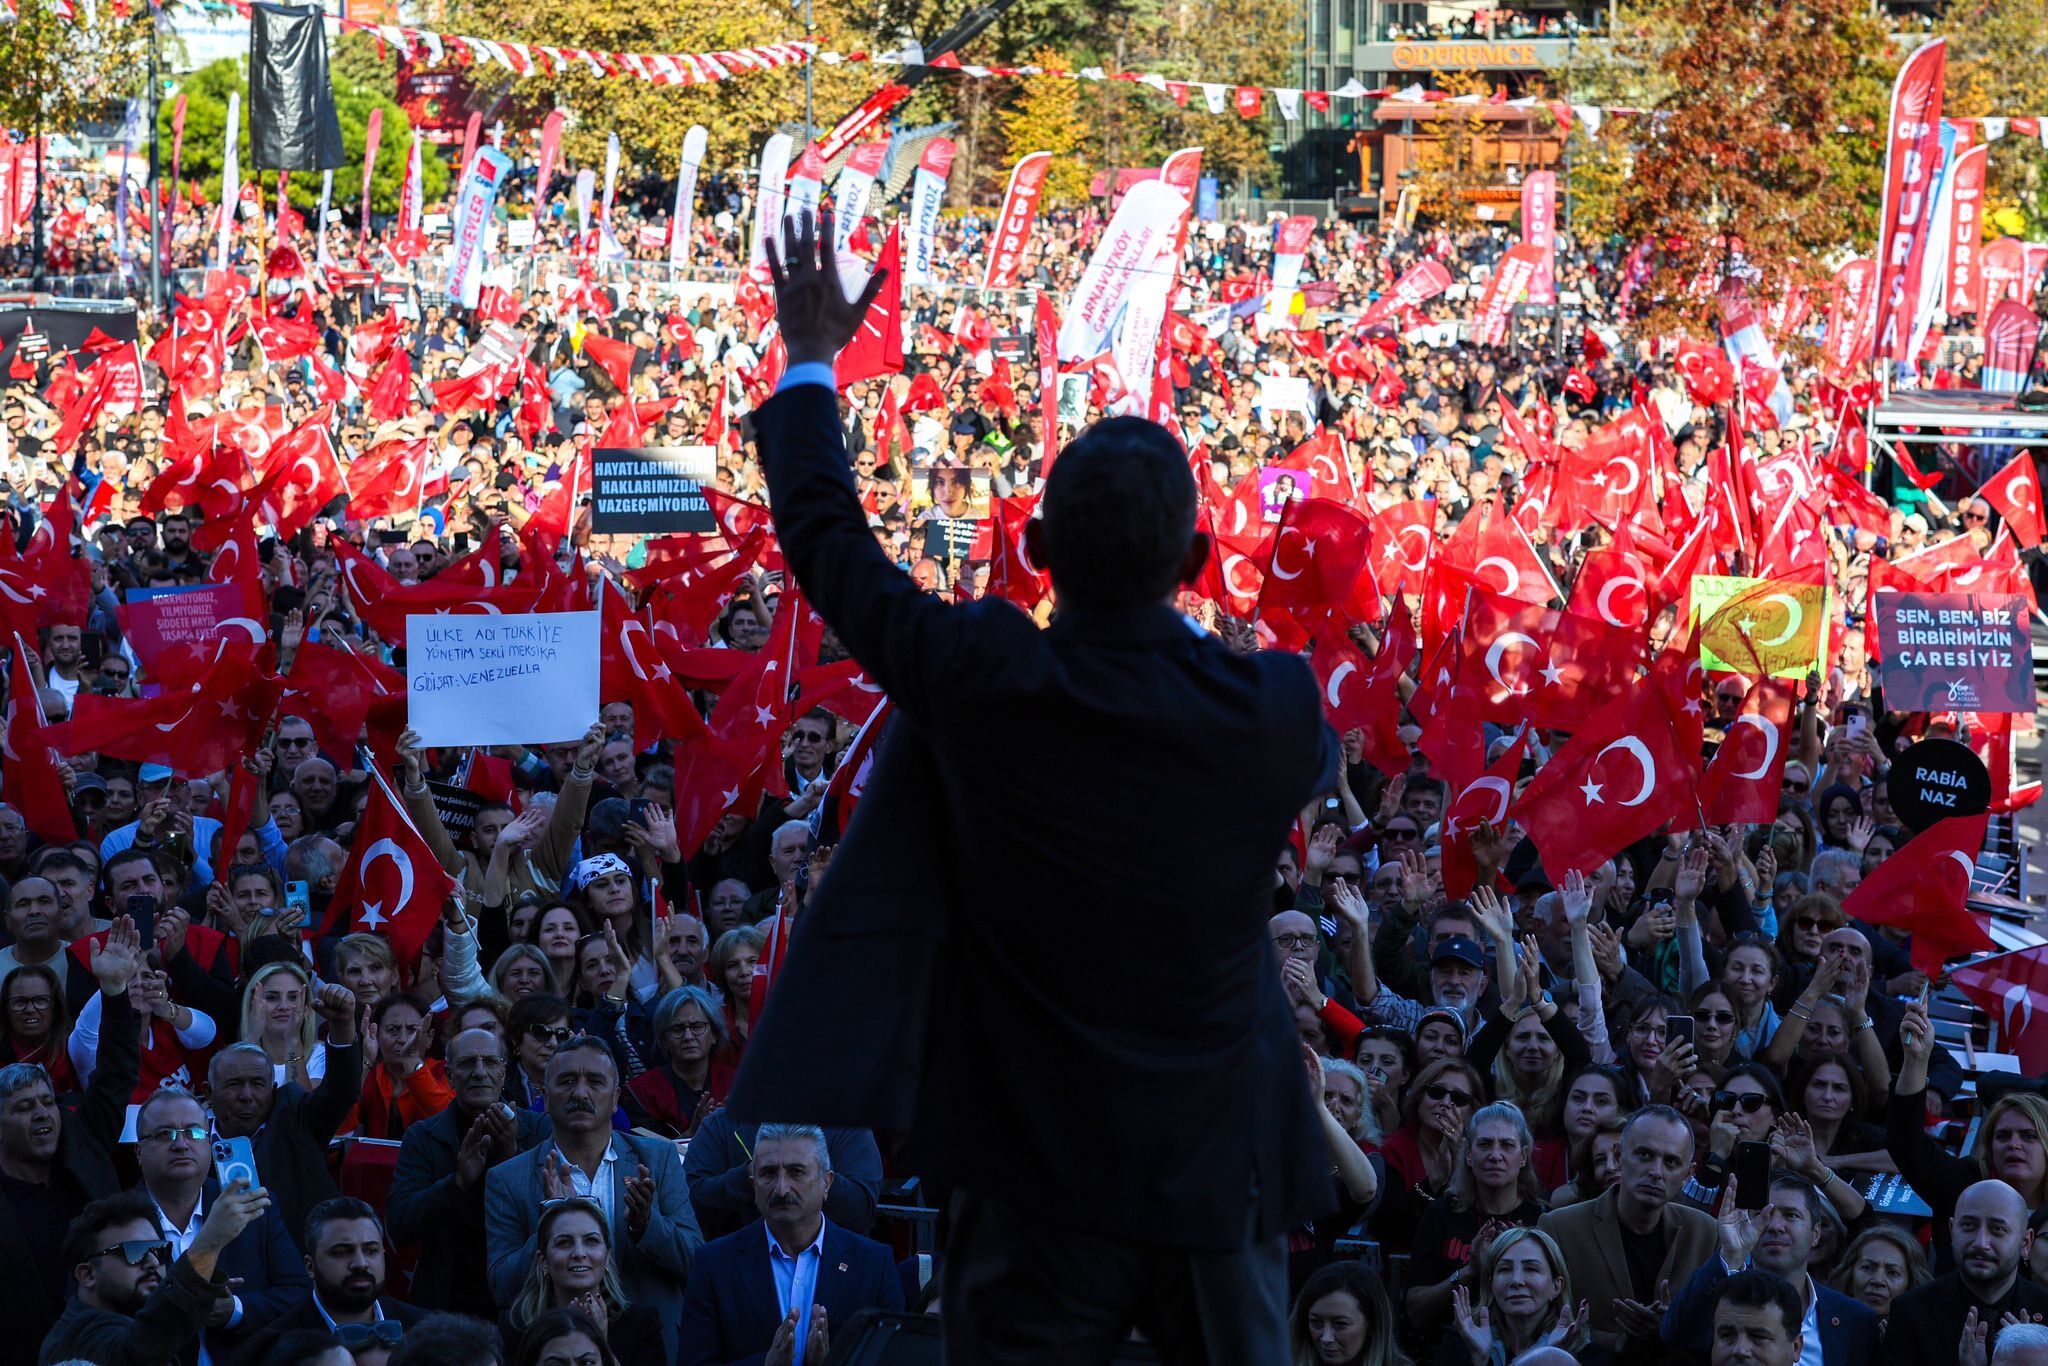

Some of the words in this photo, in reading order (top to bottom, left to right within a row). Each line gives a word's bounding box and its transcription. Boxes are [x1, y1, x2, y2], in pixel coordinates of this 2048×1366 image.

[992, 197, 1029, 287] BURSA
[1880, 150, 1922, 349] BURSA
[1123, 227, 1154, 282] KOLLARI
[1951, 203, 1974, 307] BURSA
[1081, 229, 1133, 323] ARNAVUTKÖY
[160, 605, 213, 617] YILMIYORUZ!
[191, 616, 216, 628] HAYIR
[1896, 609, 1935, 627] SEN,
[1938, 610, 1979, 627] BEN,
[1982, 608, 2011, 625] BİZ
[500, 621, 563, 643] TÜRKİYE
[1898, 627, 2012, 646] BİRBİRİMİZİN
[1900, 649, 2012, 668] ÇARESİYİZ
[1916, 767, 1968, 790] RABİA
[1920, 788, 1957, 808] NAZ
